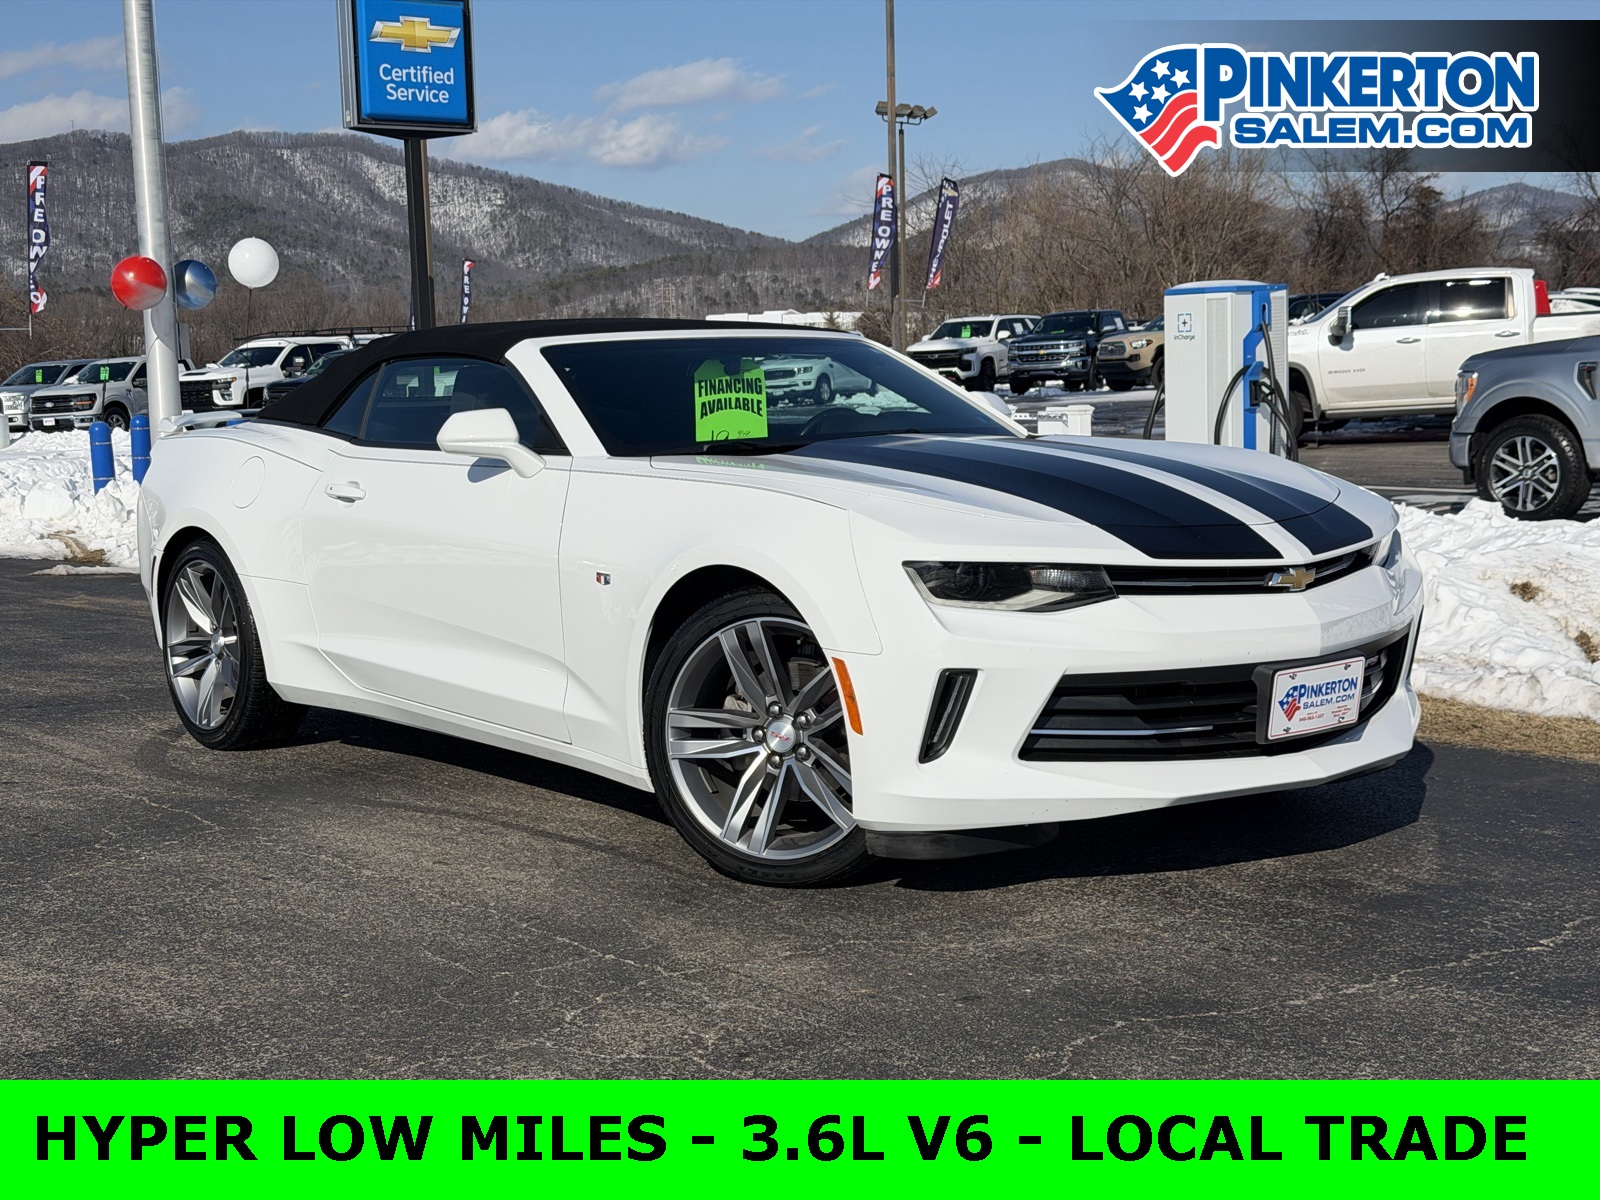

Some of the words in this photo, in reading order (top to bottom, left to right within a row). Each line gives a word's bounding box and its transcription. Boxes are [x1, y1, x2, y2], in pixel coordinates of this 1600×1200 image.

[379, 63, 455, 85] Certified
[386, 83, 450, 104] Service
[880, 184, 894, 222] PRE
[698, 377, 763, 398] FINANCING
[700, 397, 764, 420] AVAILABLE
[1297, 676, 1359, 705] PINKERTON
[1302, 693, 1355, 710] SALEM.COM
